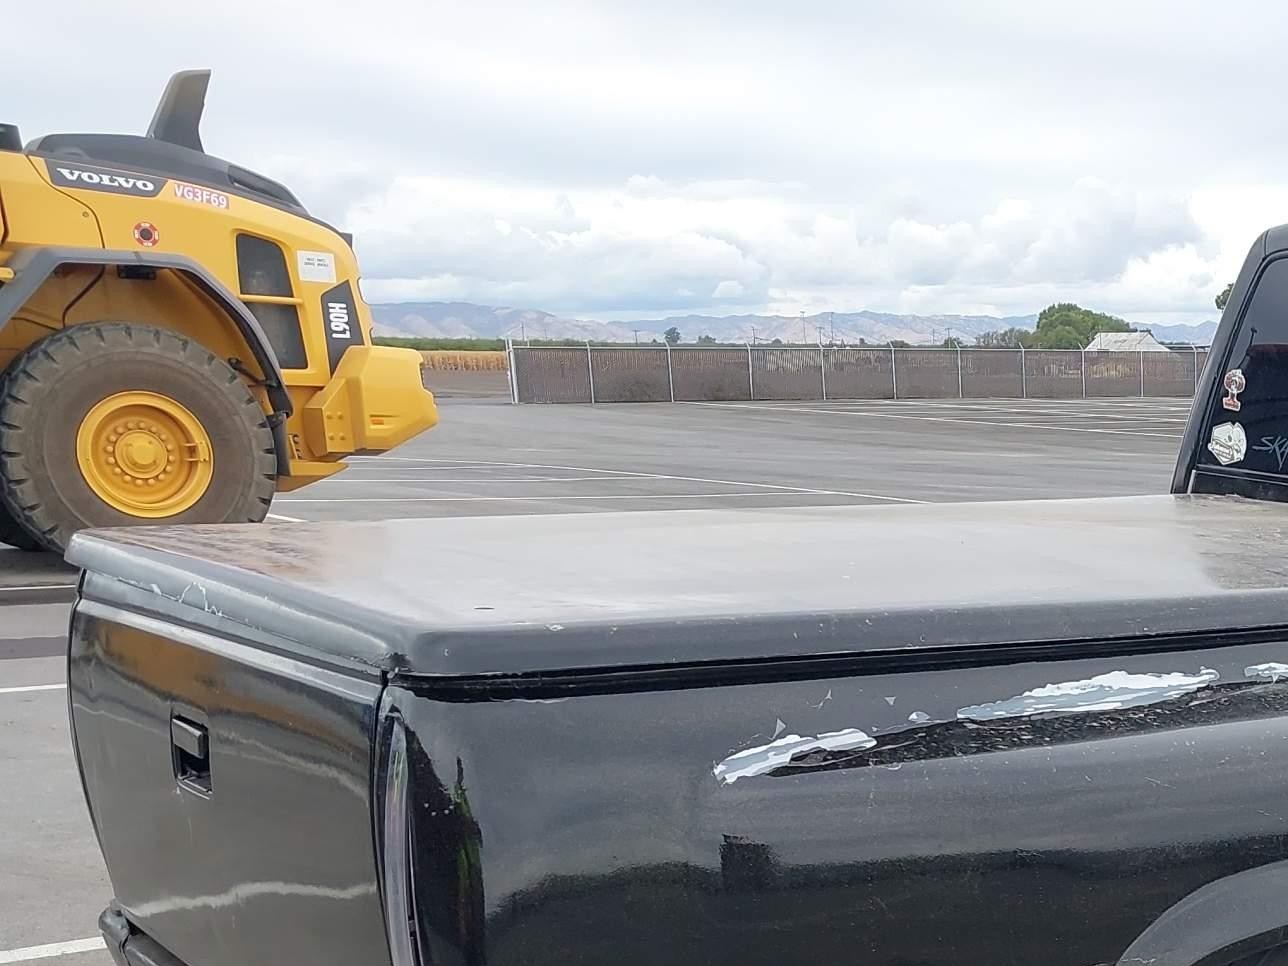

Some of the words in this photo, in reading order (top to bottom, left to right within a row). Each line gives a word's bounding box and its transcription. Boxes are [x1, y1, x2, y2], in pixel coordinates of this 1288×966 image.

[56, 167, 155, 191] VOLVO
[174, 184, 229, 209] VG3F69
[327, 302, 352, 339] L90H
